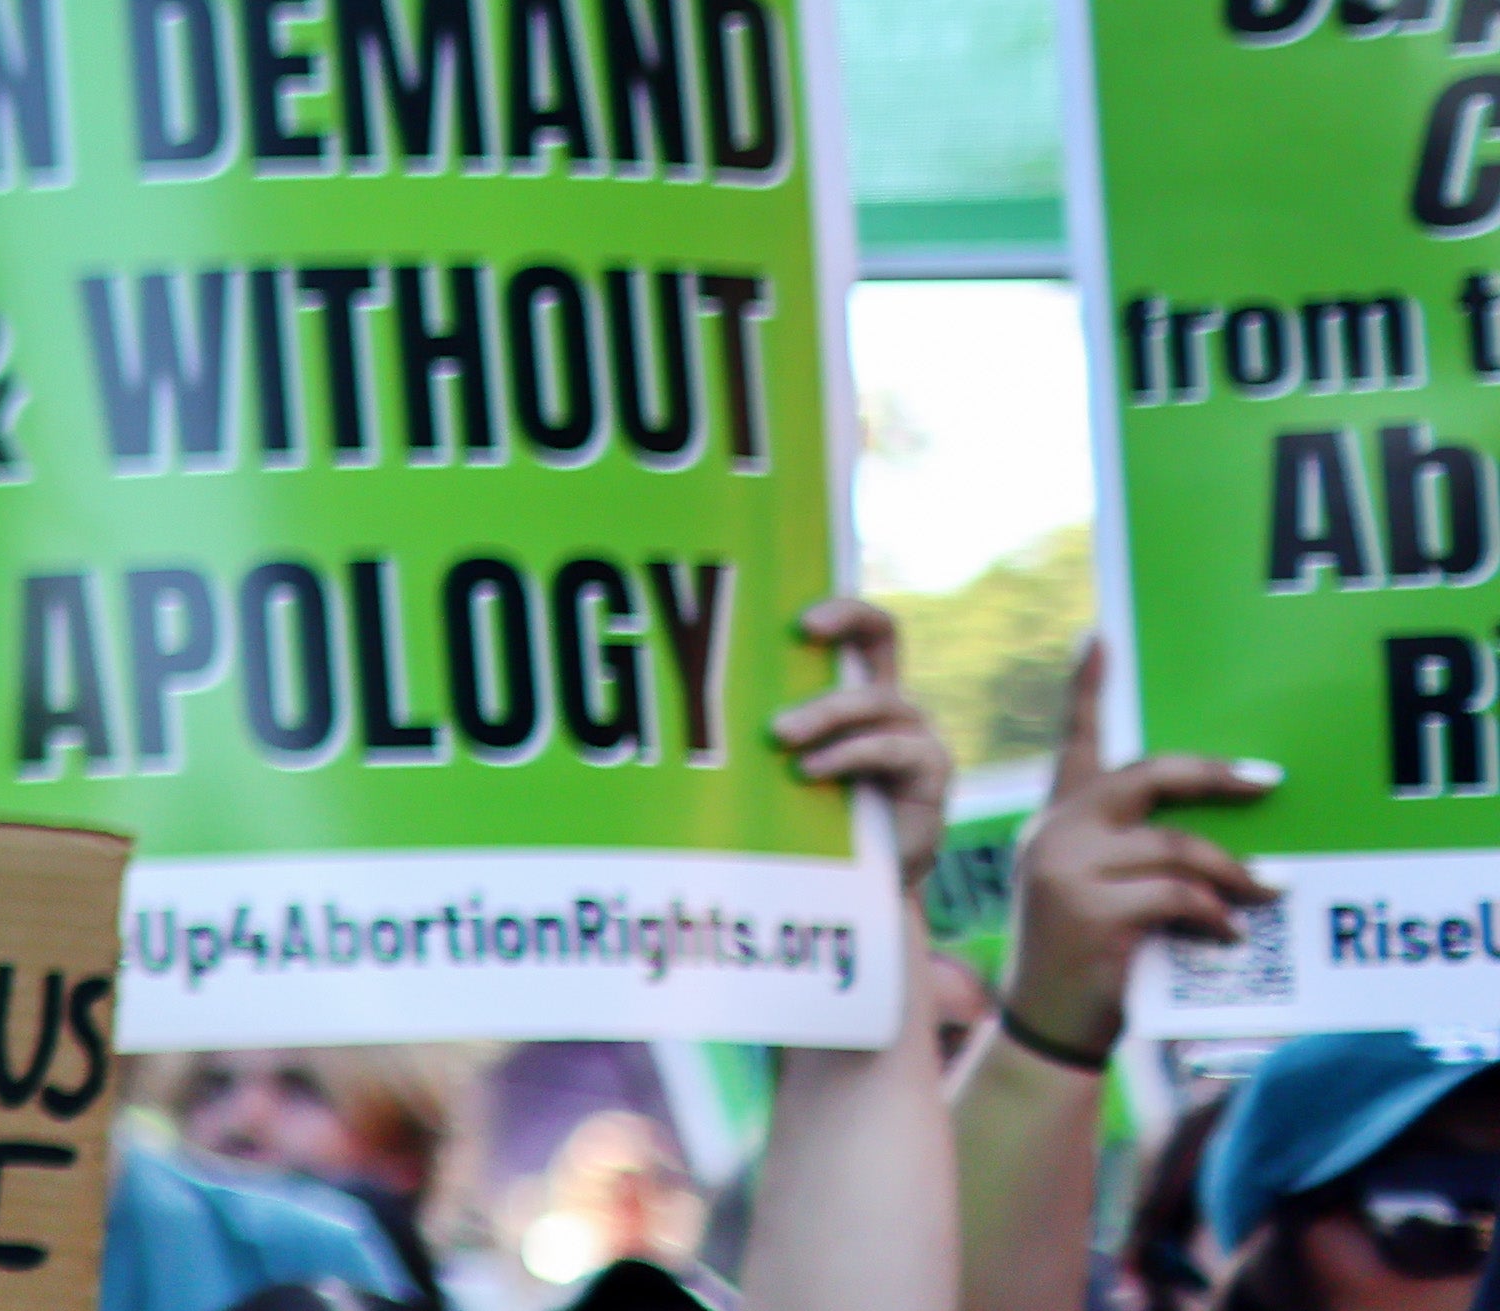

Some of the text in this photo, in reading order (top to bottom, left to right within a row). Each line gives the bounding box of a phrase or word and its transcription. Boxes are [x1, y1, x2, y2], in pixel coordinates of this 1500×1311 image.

[80, 262, 774, 478] WITHOUT
[1126, 291, 1430, 407] from
[1268, 425, 1500, 595] Ab
[14, 556, 737, 783] APOLOGY
